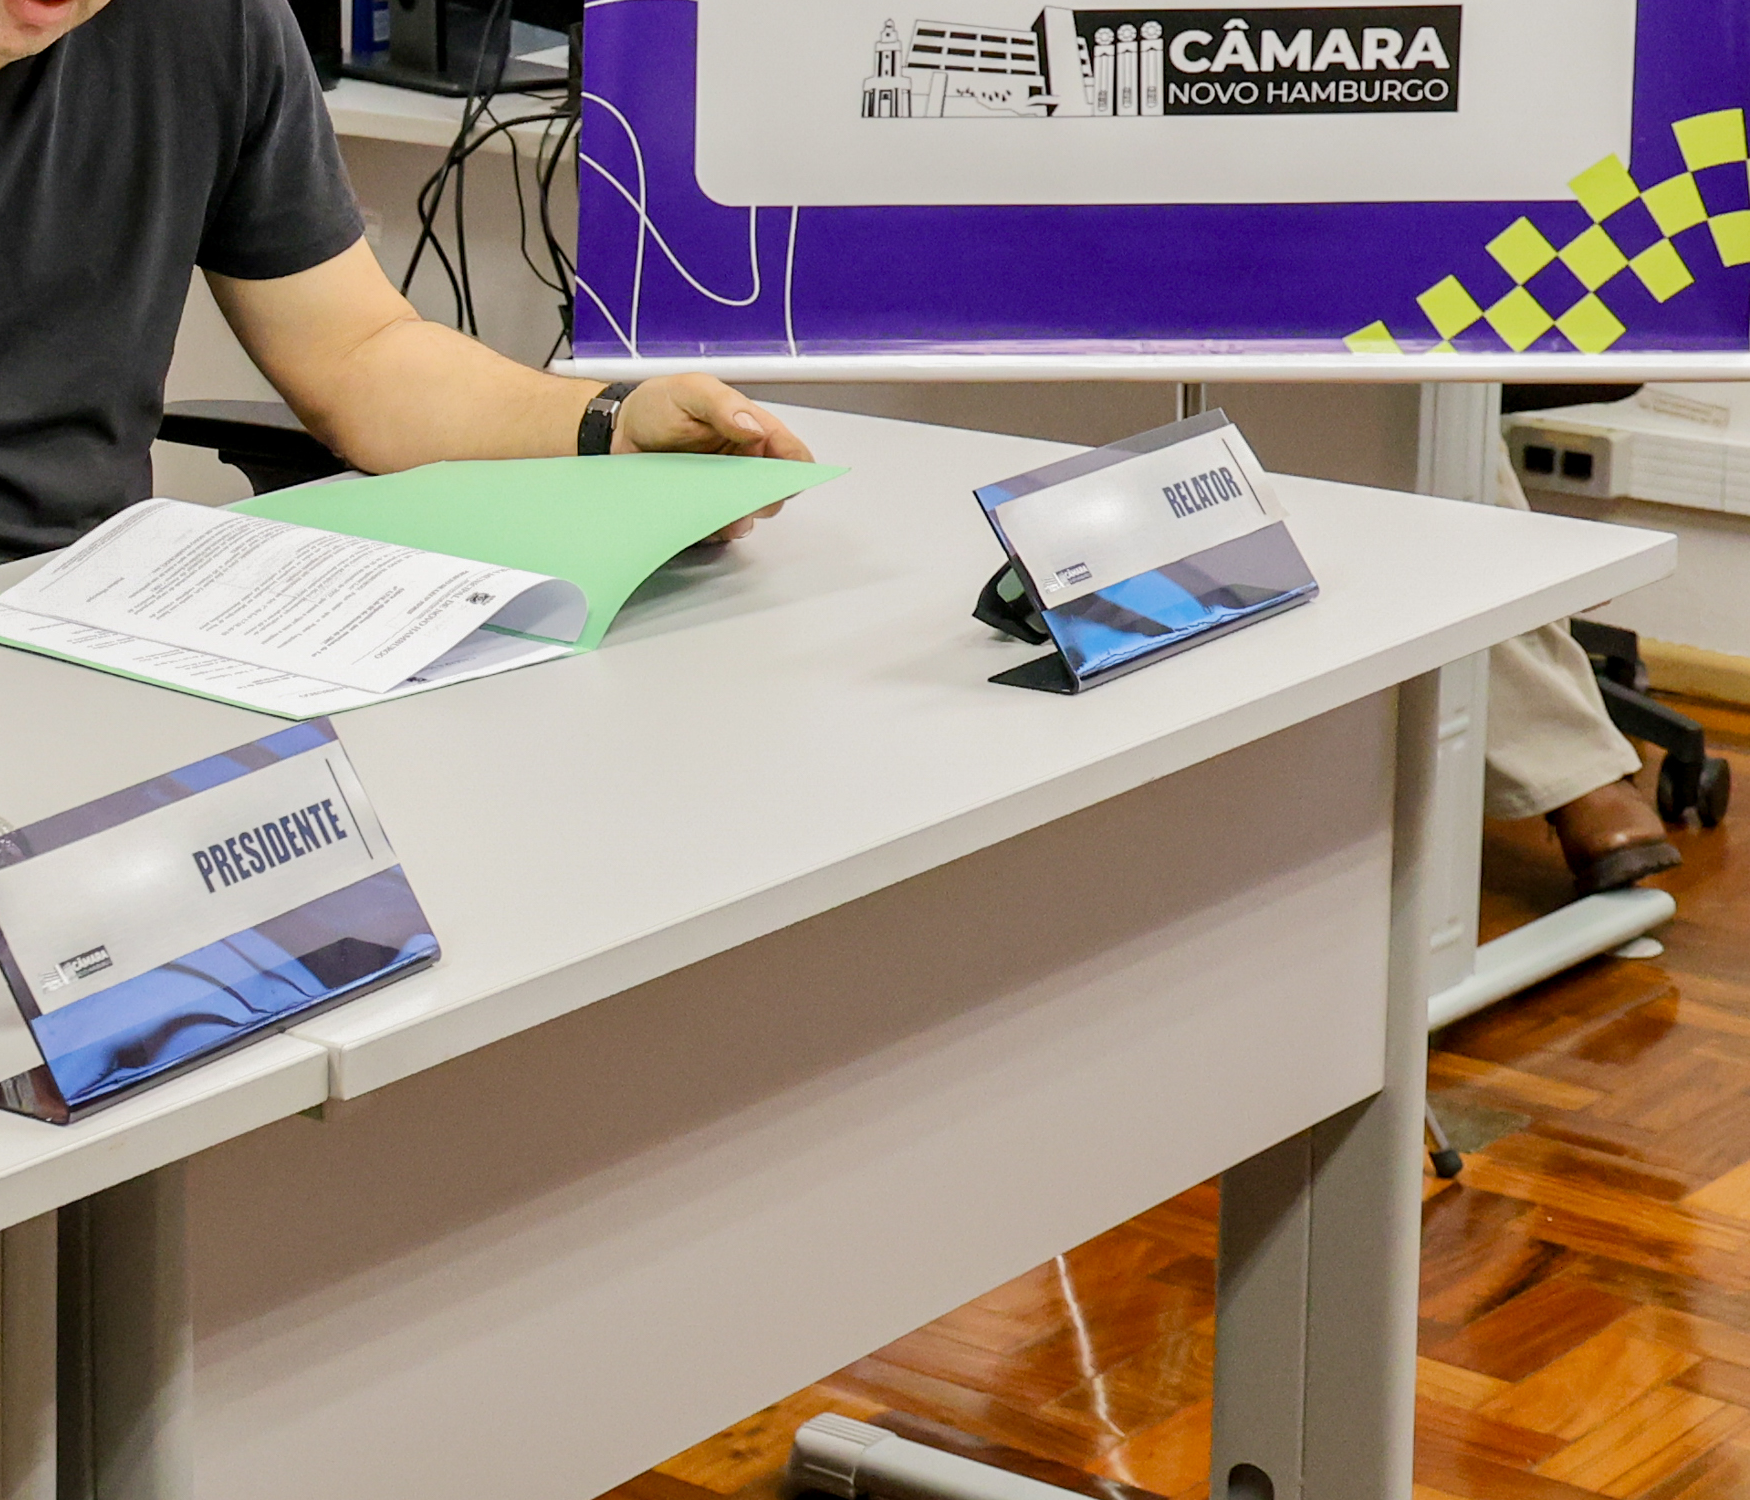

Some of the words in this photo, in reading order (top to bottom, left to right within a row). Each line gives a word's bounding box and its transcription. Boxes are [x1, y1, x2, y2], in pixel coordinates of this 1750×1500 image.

[1169, 18, 1451, 73] CÂMARA
[1168, 81, 1259, 105] NOVO
[1266, 78, 1449, 104] HAMBURGO
[1161, 465, 1243, 519] RELATOR
[192, 798, 348, 894] PRESIDENTE
